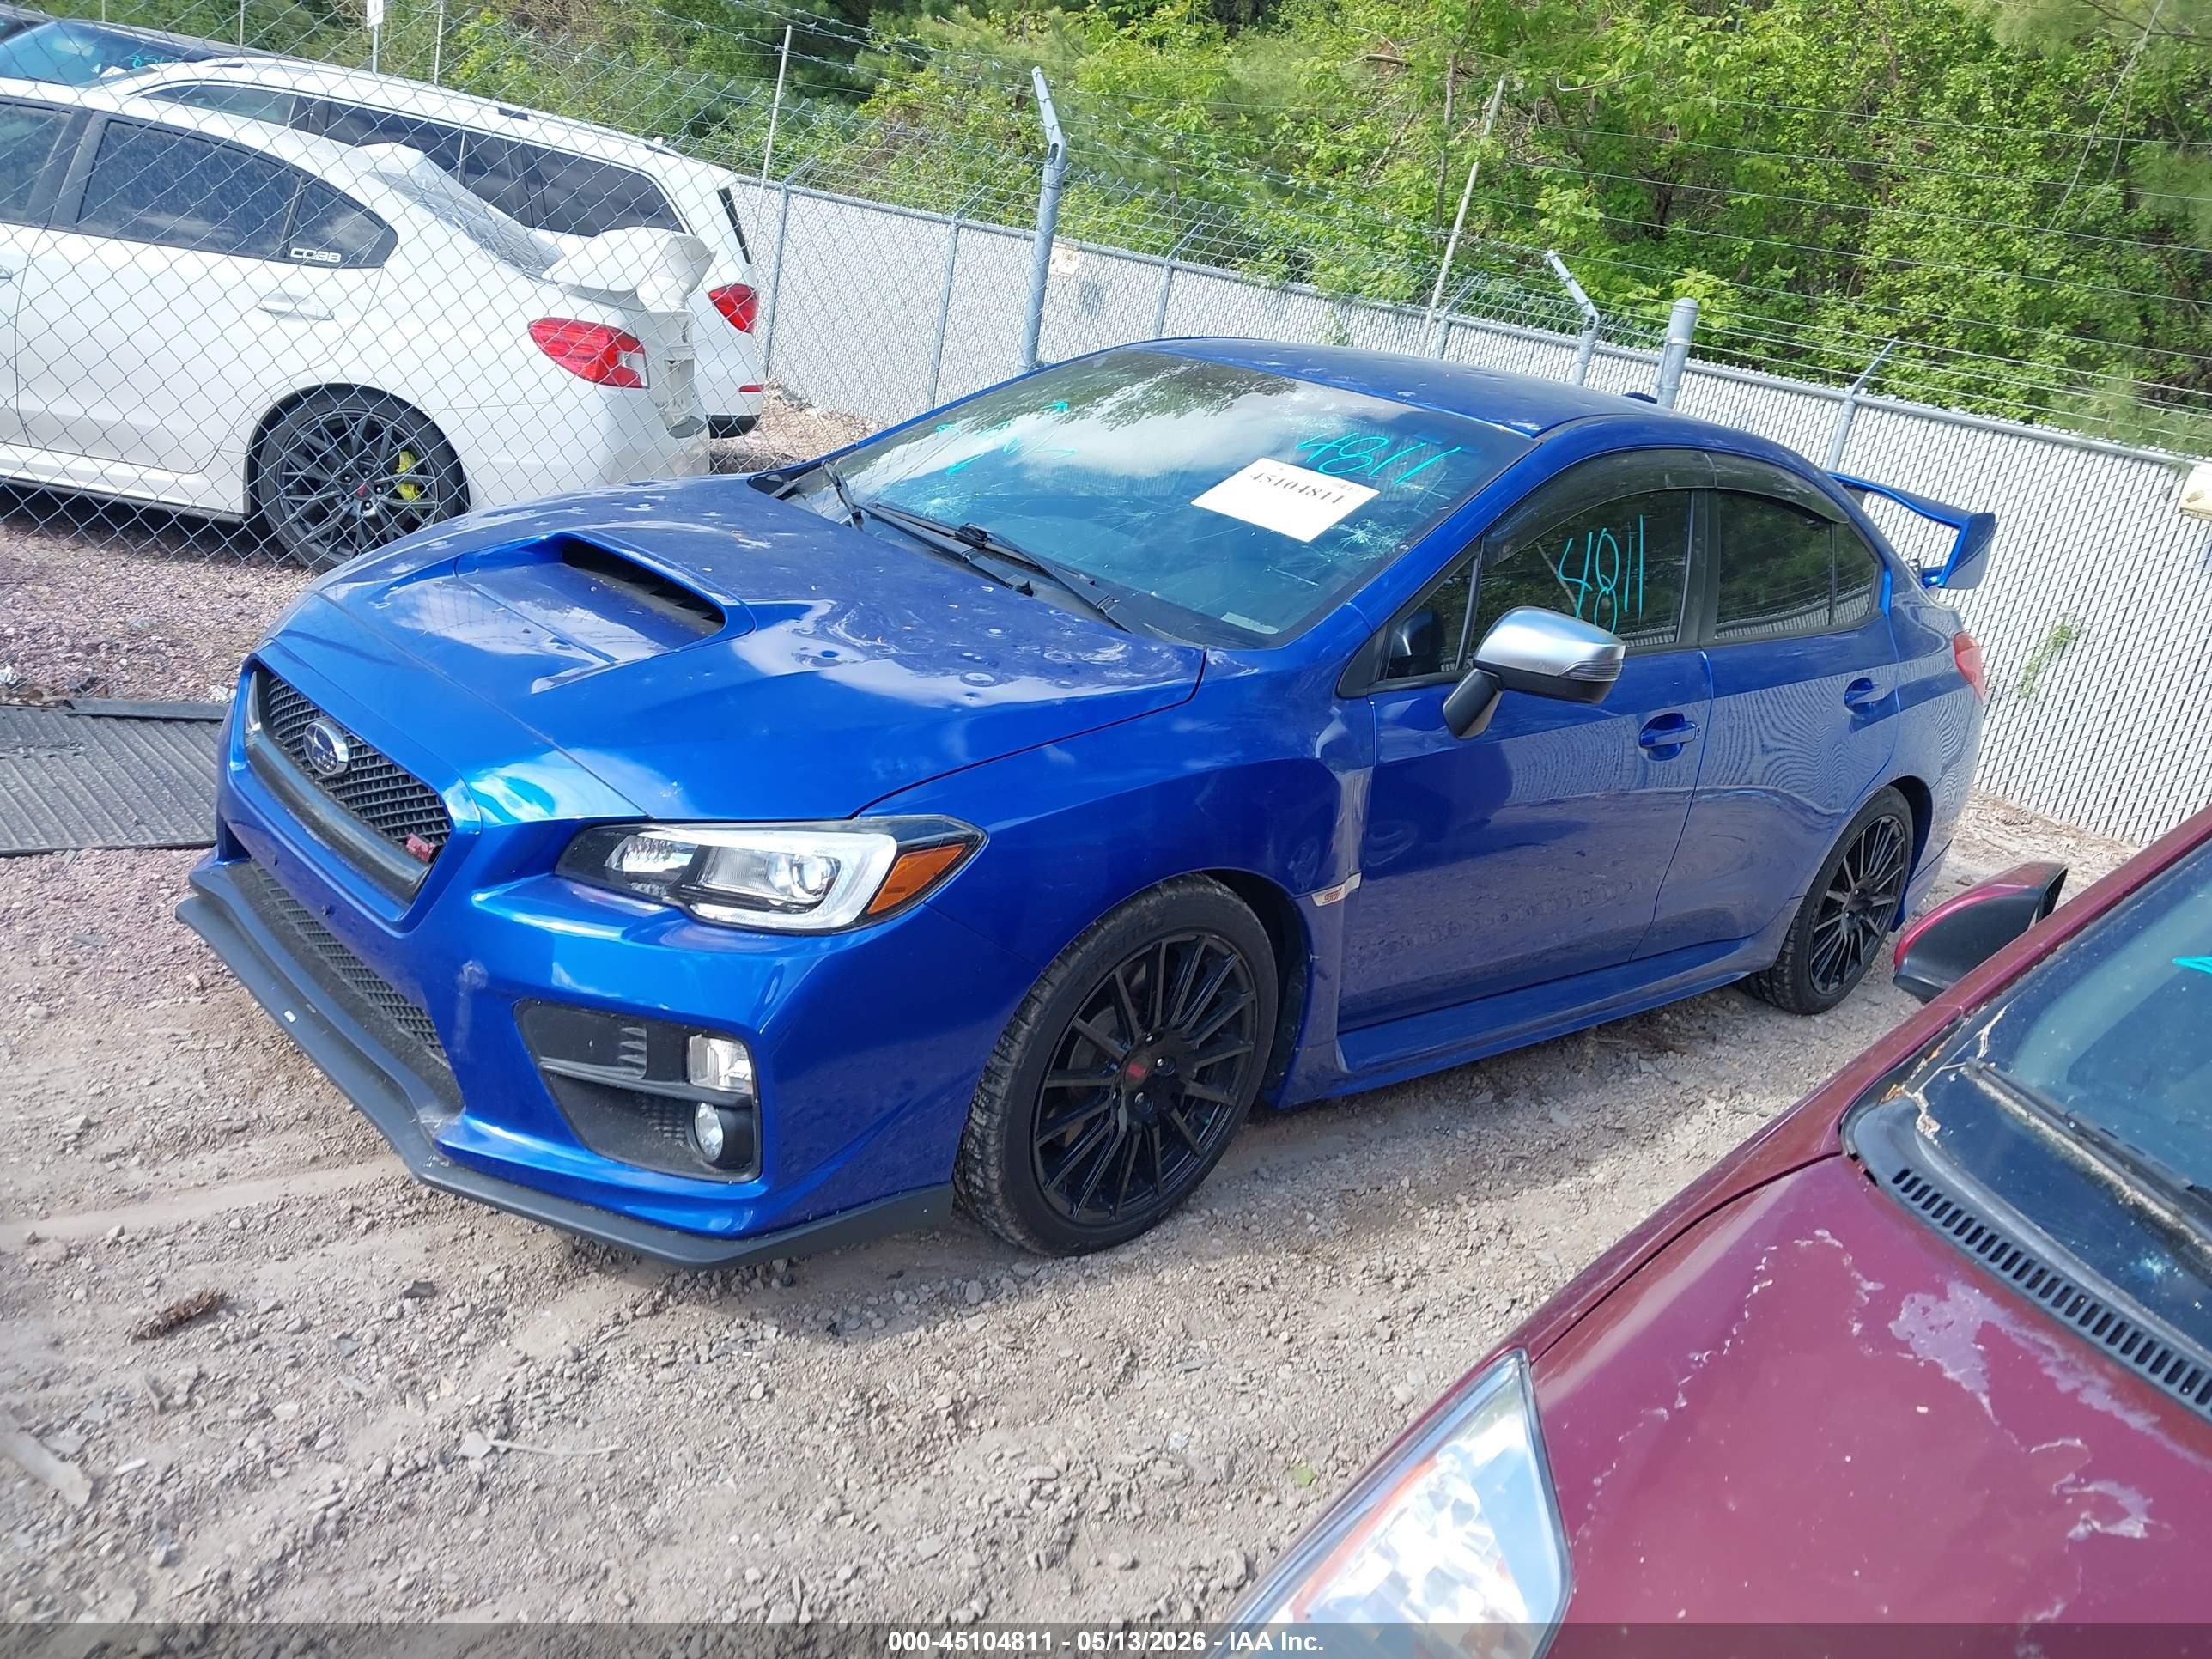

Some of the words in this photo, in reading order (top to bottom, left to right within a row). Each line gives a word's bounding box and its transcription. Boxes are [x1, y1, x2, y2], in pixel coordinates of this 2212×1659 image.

[290, 247, 342, 263] COBB
[1297, 432, 1462, 485] 4811
[1250, 472, 1345, 503] 45104811
[1559, 515, 1644, 634] 4811
